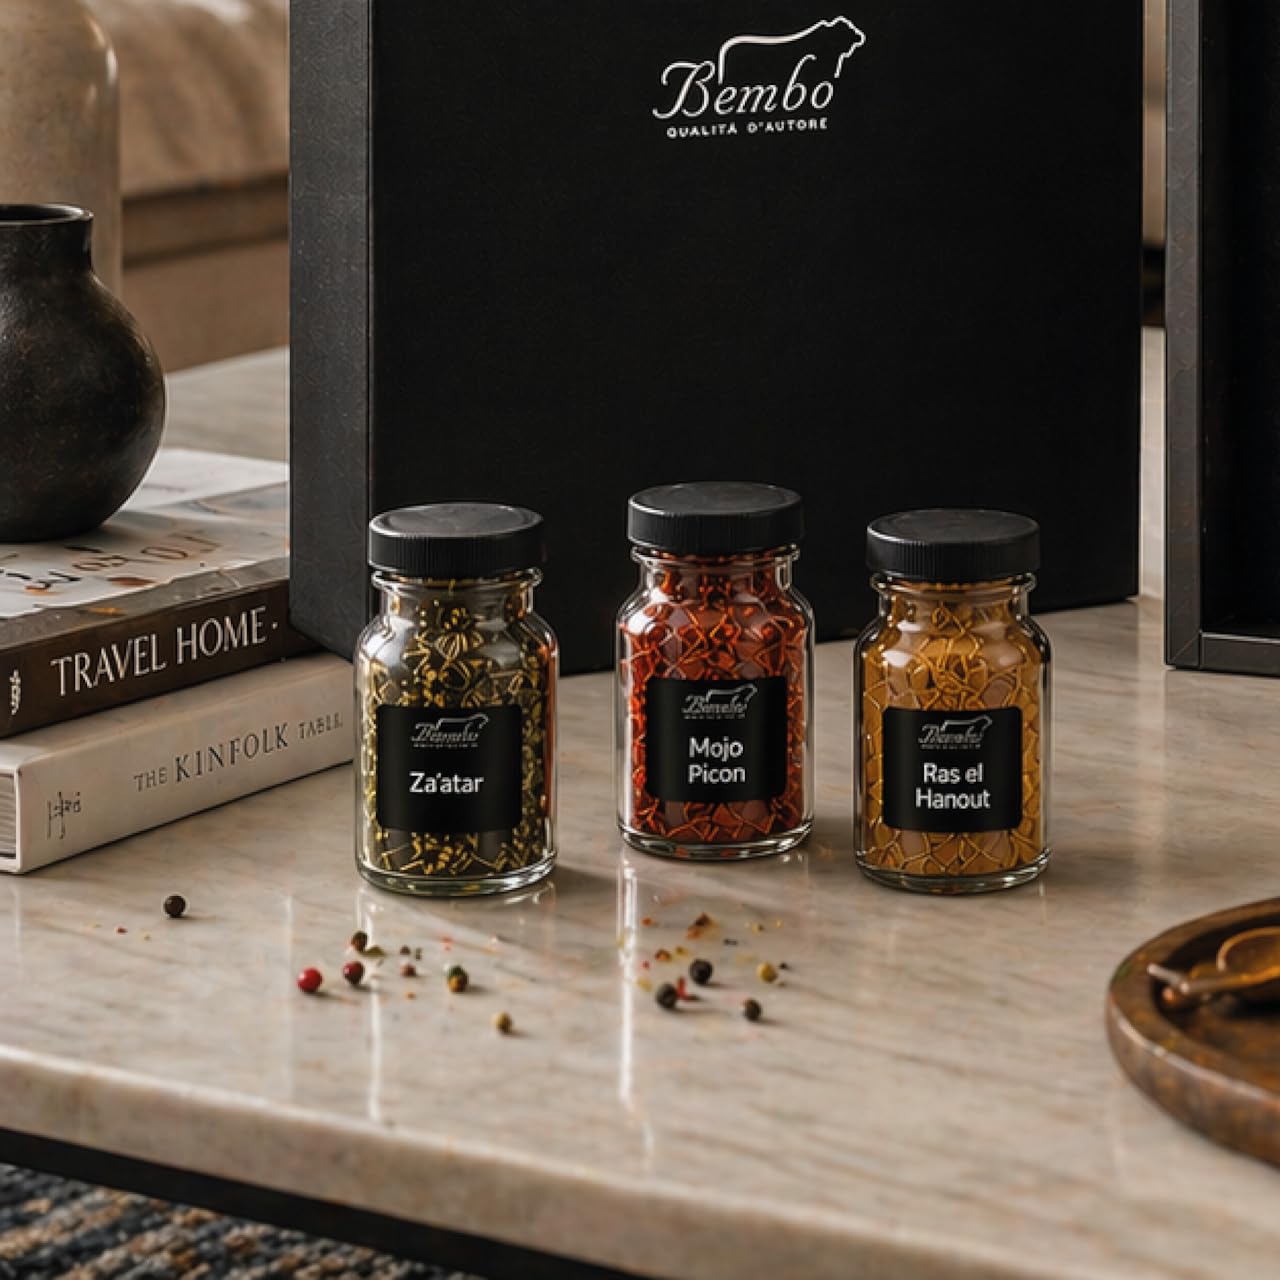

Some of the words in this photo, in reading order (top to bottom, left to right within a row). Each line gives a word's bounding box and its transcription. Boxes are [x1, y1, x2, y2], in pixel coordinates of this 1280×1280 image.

[652, 54, 836, 120] Bembo
[50, 632, 168, 696] TRAVEL
[133, 767, 168, 792] THE
[174, 721, 289, 783] KINFOLK
[689, 736, 744, 762] Mojo
[409, 771, 484, 793] Za'atar
[688, 762, 746, 784] Picon
[923, 762, 961, 785] Ras
[964, 762, 983, 783] el
[915, 787, 991, 810] Hanout
